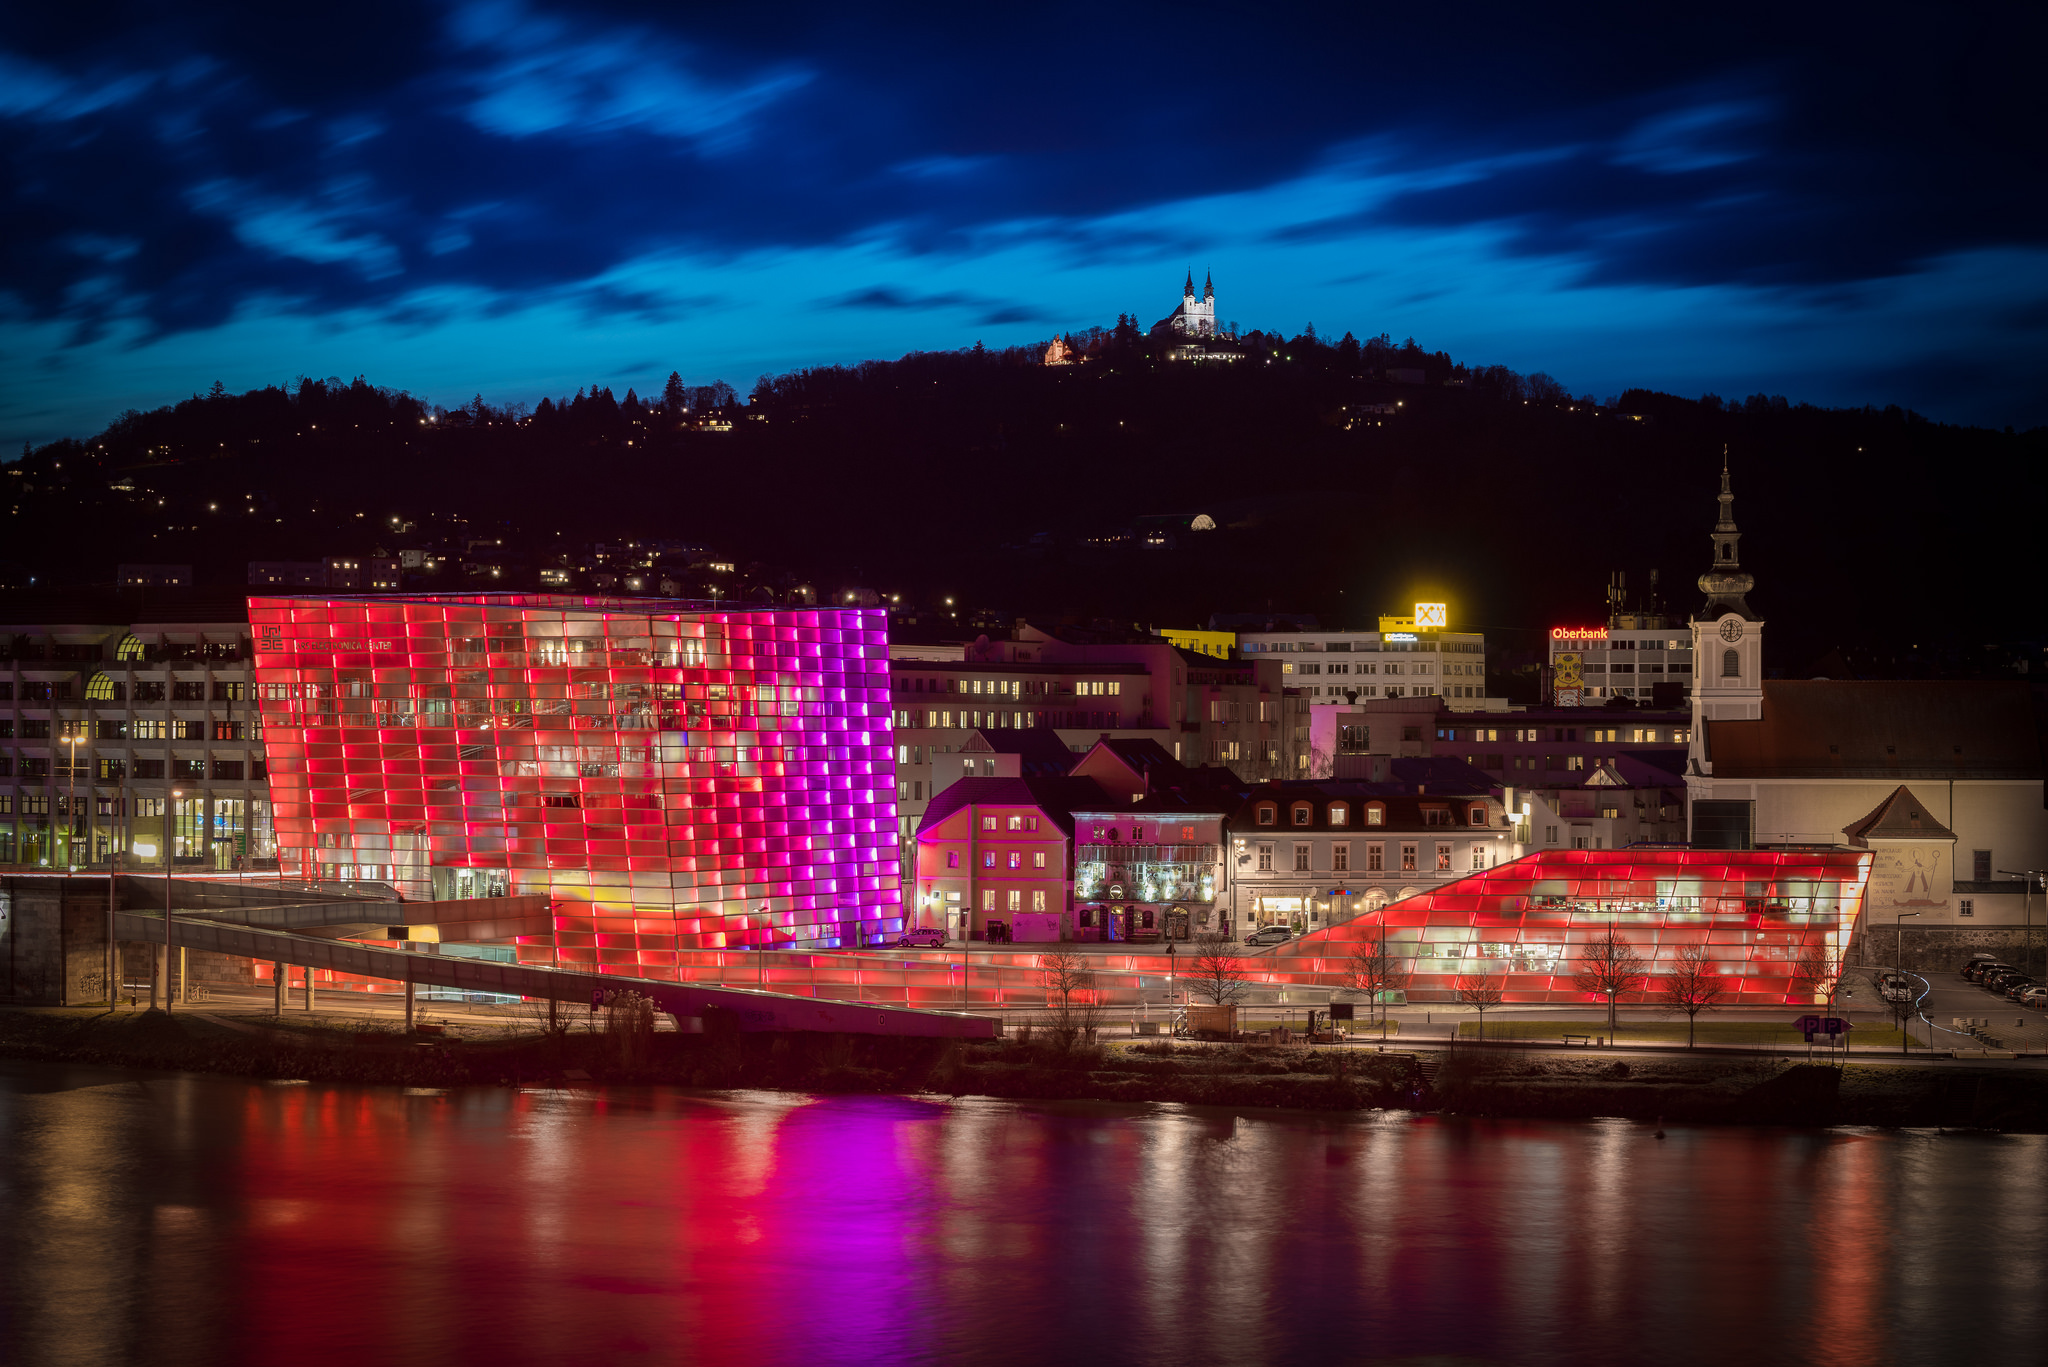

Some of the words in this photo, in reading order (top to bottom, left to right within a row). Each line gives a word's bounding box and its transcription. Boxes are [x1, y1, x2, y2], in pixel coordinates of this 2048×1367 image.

[1552, 627, 1608, 639] Oberbank
[296, 642, 310, 650] ARS
[311, 641, 362, 650] ELECTRONICA
[364, 641, 392, 650] CENTER
[593, 991, 602, 1002] P
[1806, 1020, 1817, 1032] P
[1828, 1020, 1838, 1032] P
